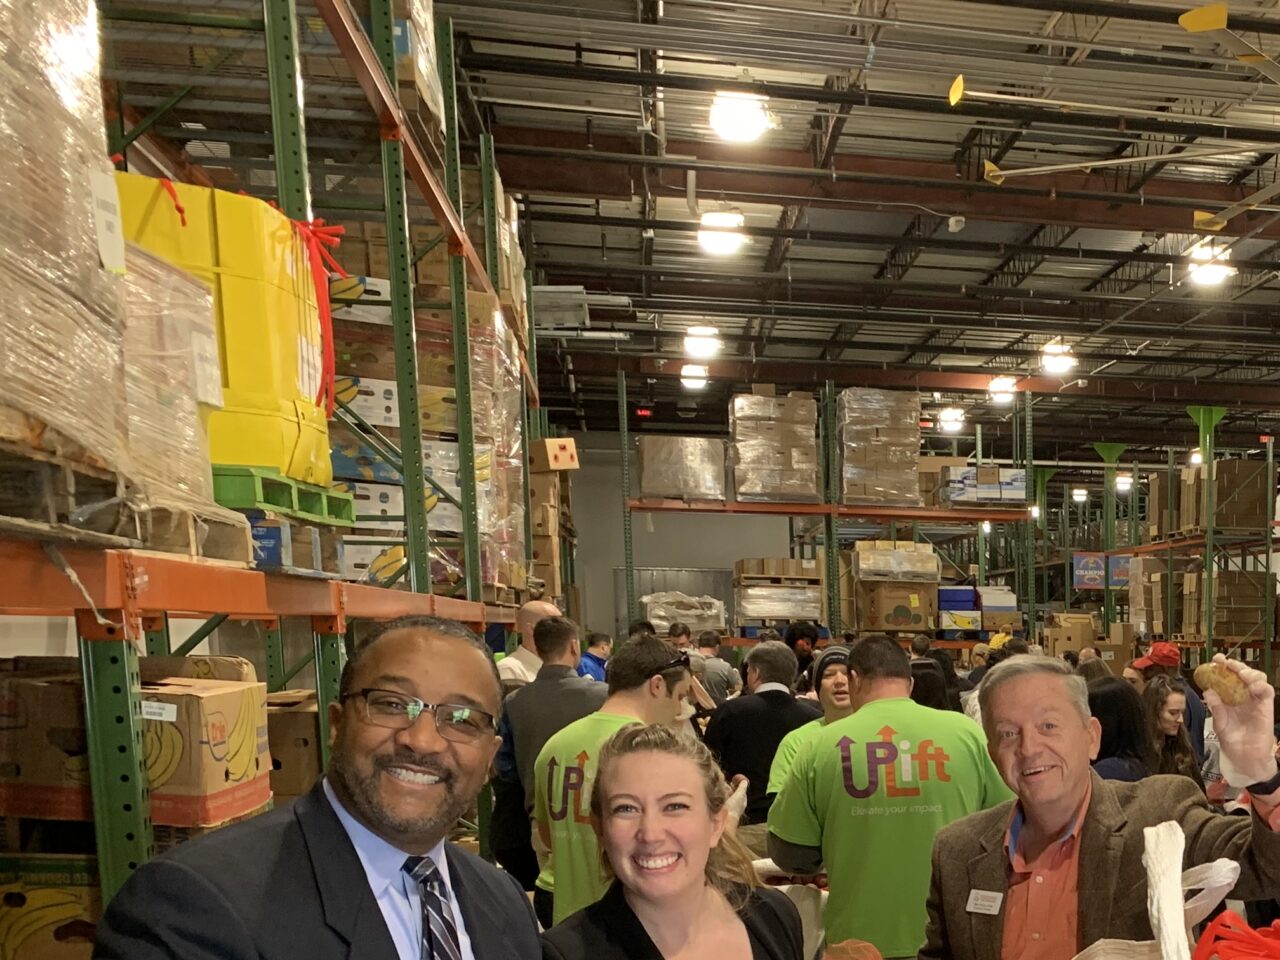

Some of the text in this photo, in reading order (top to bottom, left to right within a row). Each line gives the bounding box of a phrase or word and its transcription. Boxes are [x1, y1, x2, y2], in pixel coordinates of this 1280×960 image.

[835, 725, 952, 799] UPLift
[851, 805, 884, 816] Elevate
[884, 805, 908, 816] your
